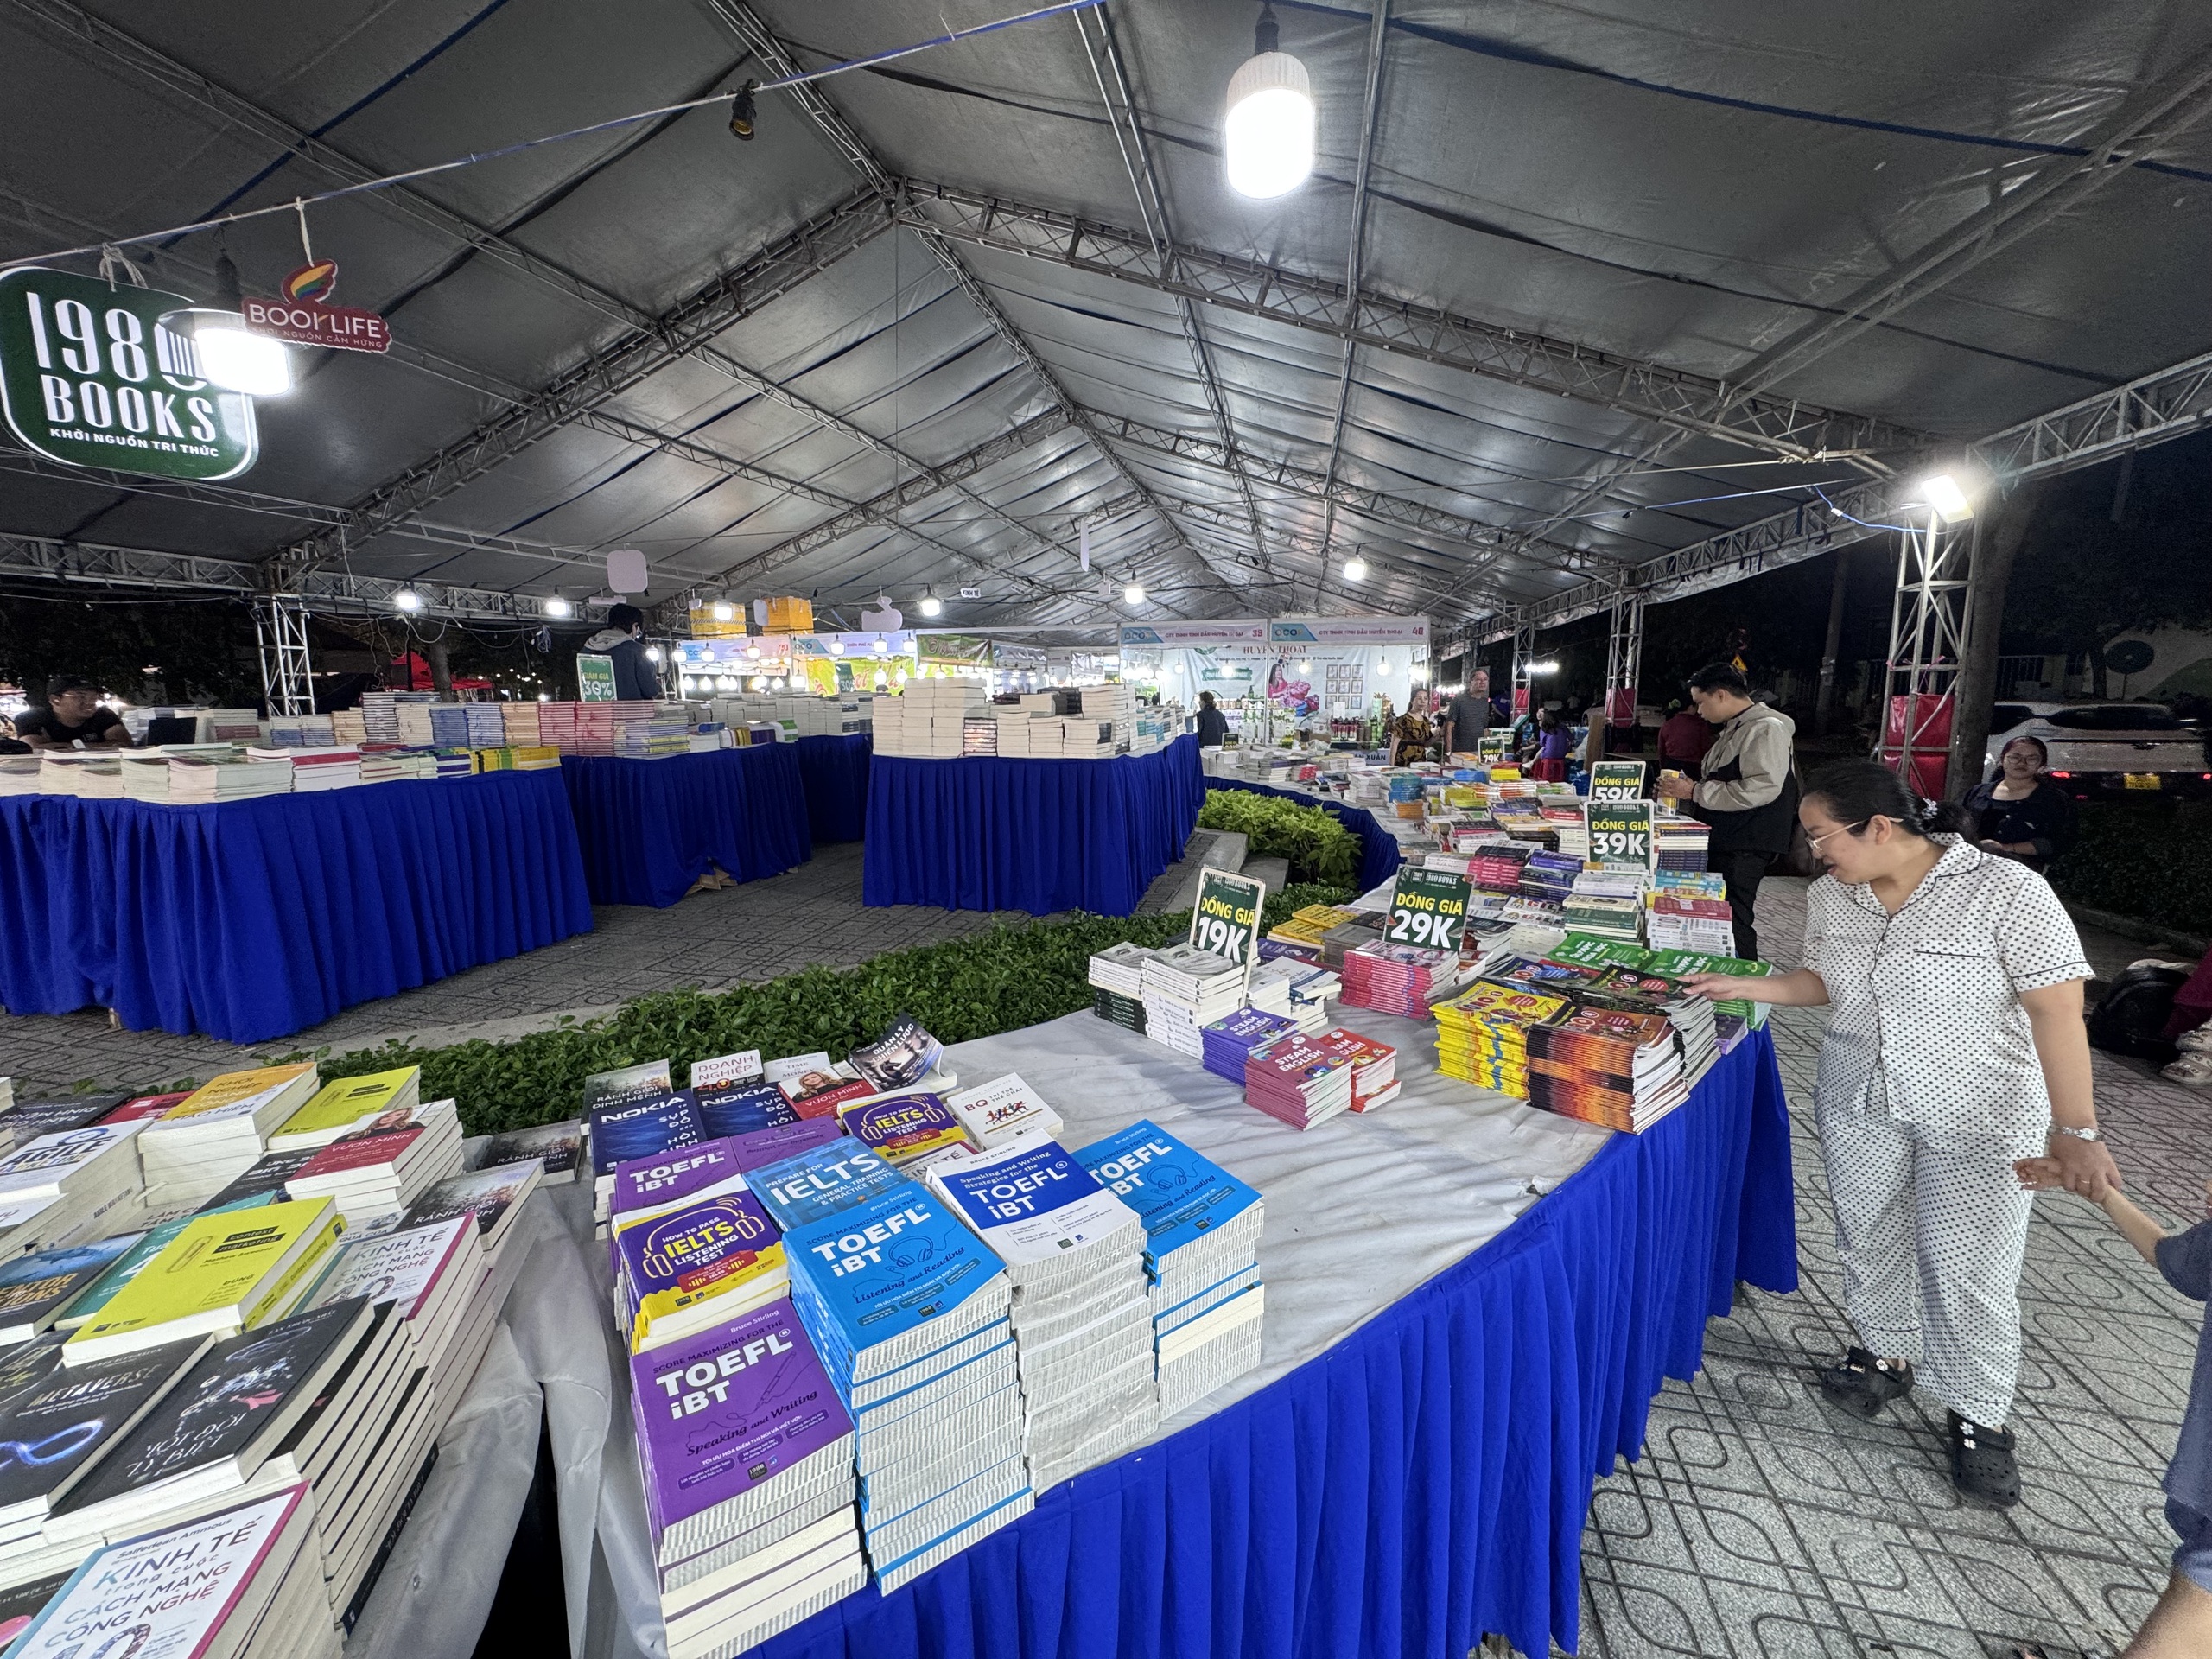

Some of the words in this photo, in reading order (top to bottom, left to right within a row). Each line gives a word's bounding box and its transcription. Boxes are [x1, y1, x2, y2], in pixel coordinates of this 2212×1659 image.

[353, 339, 382, 348] HỨNG
[41, 374, 216, 442] BOOKS
[94, 434, 148, 449] NGUỒN
[151, 441, 177, 452] TRI
[180, 443, 219, 457] THỨC
[585, 681, 613, 696] 30%
[1484, 754, 1500, 763] 79K
[1595, 776, 1622, 785] ĐỒNG
[1624, 777, 1640, 785] GIÁ
[1595, 787, 1637, 801] 59K
[1592, 818, 1625, 831] ĐỒNG
[1629, 820, 1649, 831] GIÁ
[1594, 832, 1645, 855] 39K
[1200, 895, 1233, 919] ĐỒNG
[1235, 907, 1255, 926] GIÁ
[1396, 890, 1435, 911] ĐỒNG
[1439, 899, 1463, 915] GIÁ
[1198, 916, 1248, 963] 19K
[1390, 909, 1456, 949] 29K
[1230, 1016, 1259, 1032] STEAM
[1235, 1016, 1272, 1036] ENGLISH
[873, 1036, 898, 1055] QUẢN
[1275, 1046, 1311, 1065] STEAM
[698, 1055, 753, 1072] DOANH
[782, 1068, 816, 1077] MONEY
[1279, 1049, 1325, 1071] ENGLISH
[698, 1065, 753, 1081] NGHIỆP
[702, 1086, 777, 1107] NOKIA
[837, 1084, 863, 1095] MÌNH
[601, 1096, 685, 1122] NOKIA
[964, 1100, 988, 1111] BQ
[874, 1109, 924, 1129] IELTS
[882, 1118, 927, 1134] LISTENING
[896, 1126, 918, 1135] TEST
[1115, 1135, 1128, 1145] Bruce
[1128, 1127, 1147, 1140] Stirling
[1, 1137, 110, 1166] AGILE
[969, 1155, 989, 1165] BRUCE
[990, 1147, 1016, 1158] STIRLING
[1093, 1145, 1130, 1166] MAXIMIZING
[1129, 1138, 1142, 1148] FOR
[1142, 1133, 1154, 1142] THE
[765, 1170, 804, 1188] PREPARE
[806, 1164, 823, 1173] FOR
[771, 1153, 880, 1205] IELTS
[959, 1169, 999, 1185] Speaking
[1001, 1164, 1017, 1174] and
[1017, 1151, 1052, 1168] Writing
[963, 1175, 1009, 1190] Strategies
[1009, 1170, 1022, 1179] for
[1023, 1163, 1039, 1173] the
[636, 1174, 678, 1194] iBT
[812, 1183, 851, 1203] GENERAL
[850, 1167, 889, 1185] TRAINING
[830, 1180, 868, 1204] PRACTICE
[868, 1172, 893, 1185] TESTS
[1174, 1192, 1185, 1203] and
[1185, 1174, 1216, 1197] Reading
[870, 1200, 889, 1211] Bruce
[889, 1190, 912, 1203] Stirling
[988, 1194, 1036, 1220] iBT
[662, 1232, 683, 1243] HOW
[698, 1217, 721, 1230] PASS
[806, 1232, 835, 1245] SCORE
[836, 1211, 885, 1235] MAXIMIZING
[886, 1205, 901, 1216] FOR
[902, 1197, 917, 1206] THE
[218, 1235, 282, 1251] marketing
[229, 1227, 274, 1241] context
[353, 1239, 412, 1262] KINH
[418, 1227, 449, 1242] TẾ
[664, 1221, 734, 1259] IELTS
[340, 1261, 384, 1276] CÁCH
[389, 1249, 435, 1263] MẠNG
[674, 1234, 739, 1266] LISTENING
[693, 1248, 724, 1266] TEST
[831, 1245, 881, 1277] iBT
[334, 1270, 379, 1287] CÔNG
[385, 1256, 430, 1274] NGHỆ
[855, 1280, 905, 1304] Listening
[908, 1272, 924, 1283] and
[923, 1246, 964, 1275] Reading
[730, 1321, 753, 1333] Bruce
[753, 1309, 779, 1325] Stirling
[652, 1357, 686, 1374] SCORE
[688, 1335, 746, 1362] MAXIMIZING
[747, 1328, 765, 1339] FOR
[766, 1319, 785, 1330] THE
[27, 1364, 162, 1408] METAVERSE
[670, 1380, 730, 1420] iBT
[687, 1426, 747, 1457] Speaking
[771, 1390, 817, 1419] Writing
[119, 1535, 178, 1557] Saifedean
[180, 1519, 232, 1539] Ammous
[92, 1543, 199, 1590] KINH
[209, 1514, 265, 1553] TẾ
[105, 1574, 163, 1597] trong
[173, 1554, 219, 1574] cuộc
[64, 1592, 145, 1624] CÁCH
[152, 1561, 232, 1595] MẠNG
[45, 1611, 132, 1649] CÔNG
[137, 1580, 219, 1619] NGHỆ
